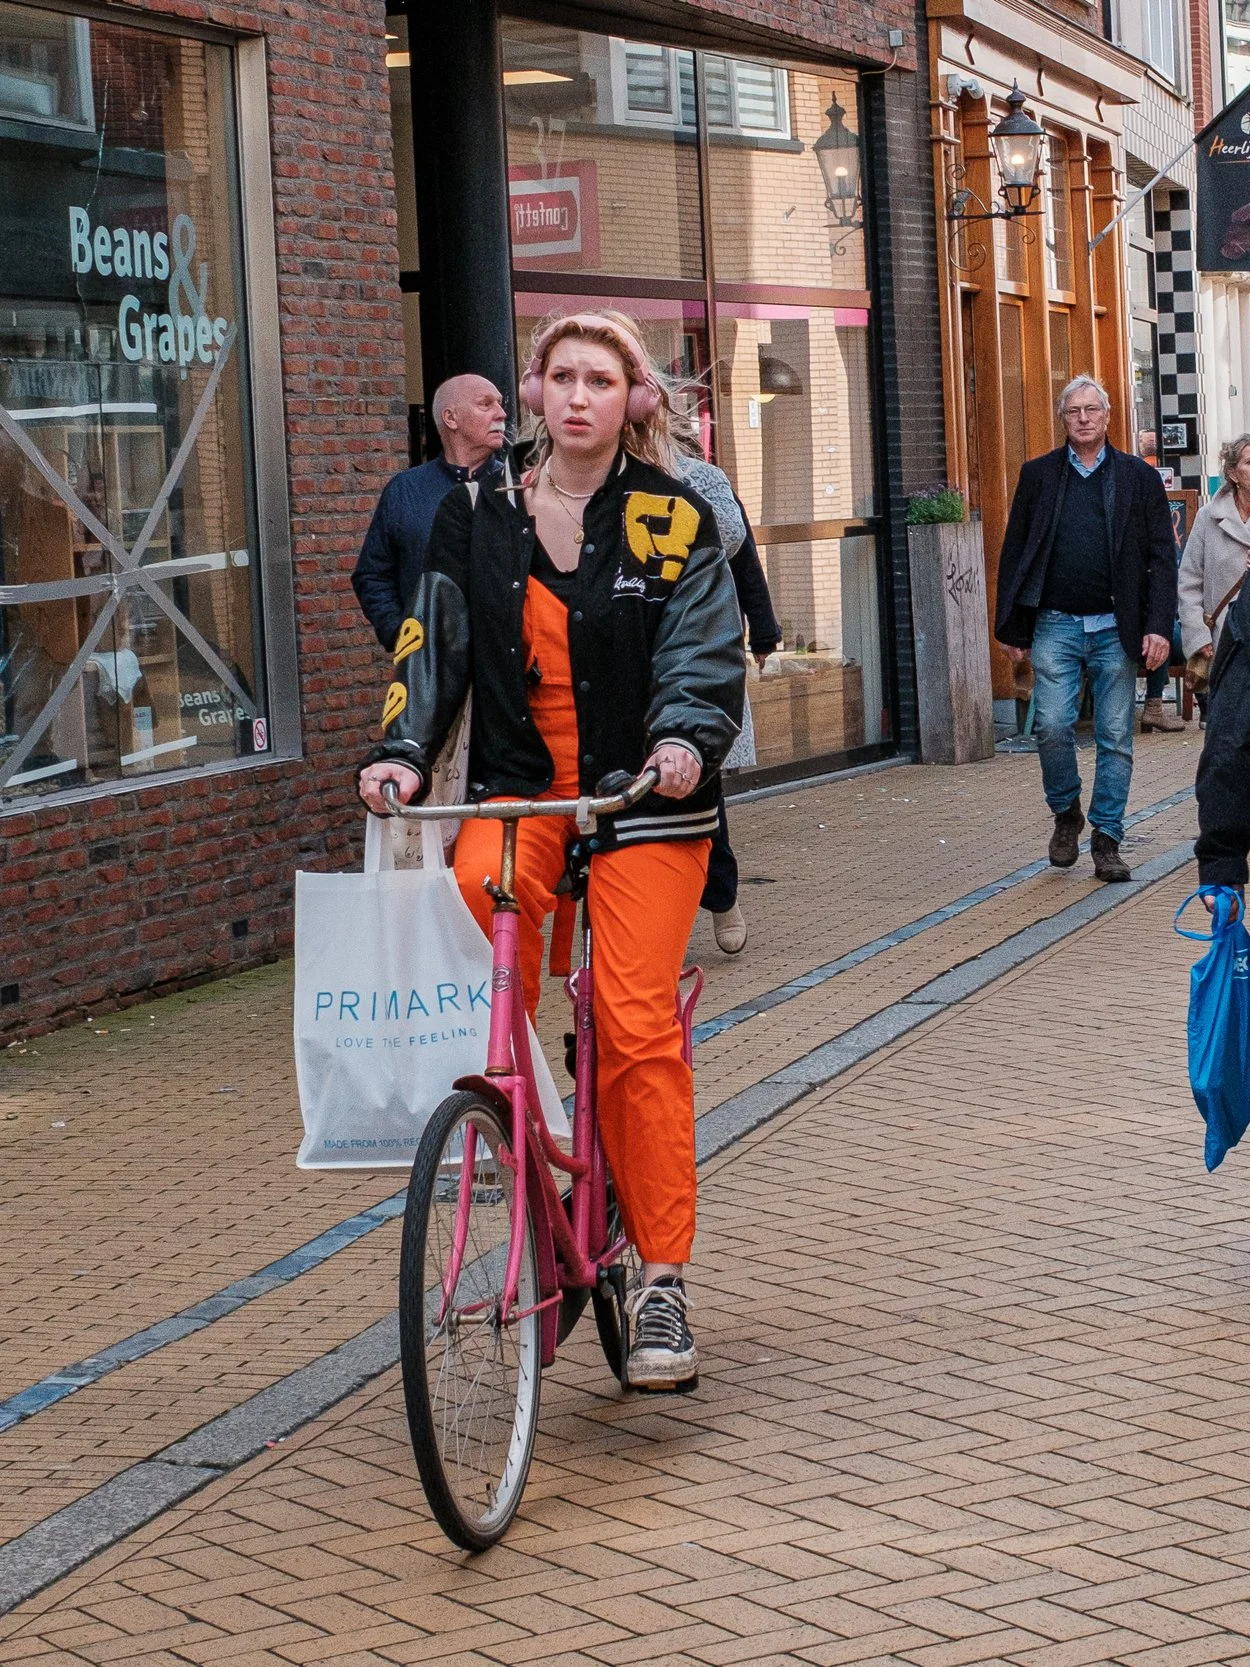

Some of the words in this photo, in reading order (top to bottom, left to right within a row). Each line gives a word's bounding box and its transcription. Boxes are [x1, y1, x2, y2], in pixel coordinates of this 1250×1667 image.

[69, 206, 170, 281] Beans
[119, 294, 228, 381] Grapes
[199, 707, 250, 726] Grae
[315, 981, 491, 1021] PRIMARK
[336, 1037, 374, 1049] LOVE
[409, 1027, 478, 1047] FEELING
[324, 1139, 349, 1149] MADE
[350, 1139, 377, 1148] FROM
[379, 1138, 401, 1148] 100%
